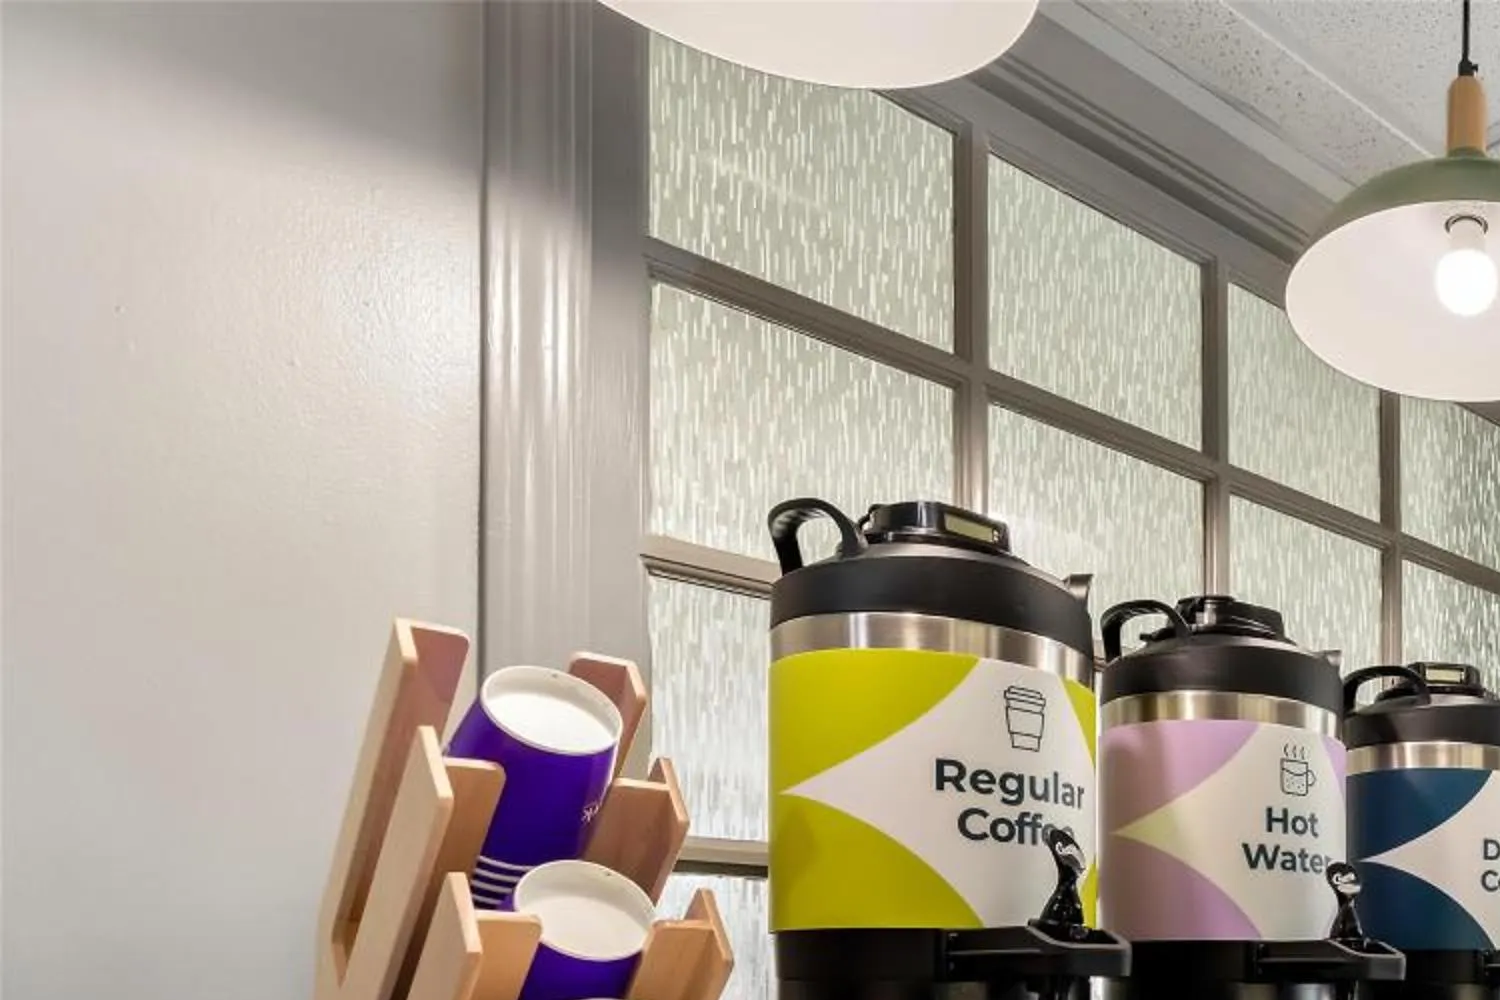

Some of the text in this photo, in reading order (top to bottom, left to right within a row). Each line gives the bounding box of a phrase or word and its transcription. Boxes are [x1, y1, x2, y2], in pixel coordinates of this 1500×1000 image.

[935, 757, 1085, 809] Regular
[957, 807, 1075, 847] Coff
[1265, 805, 1319, 839] Hot
